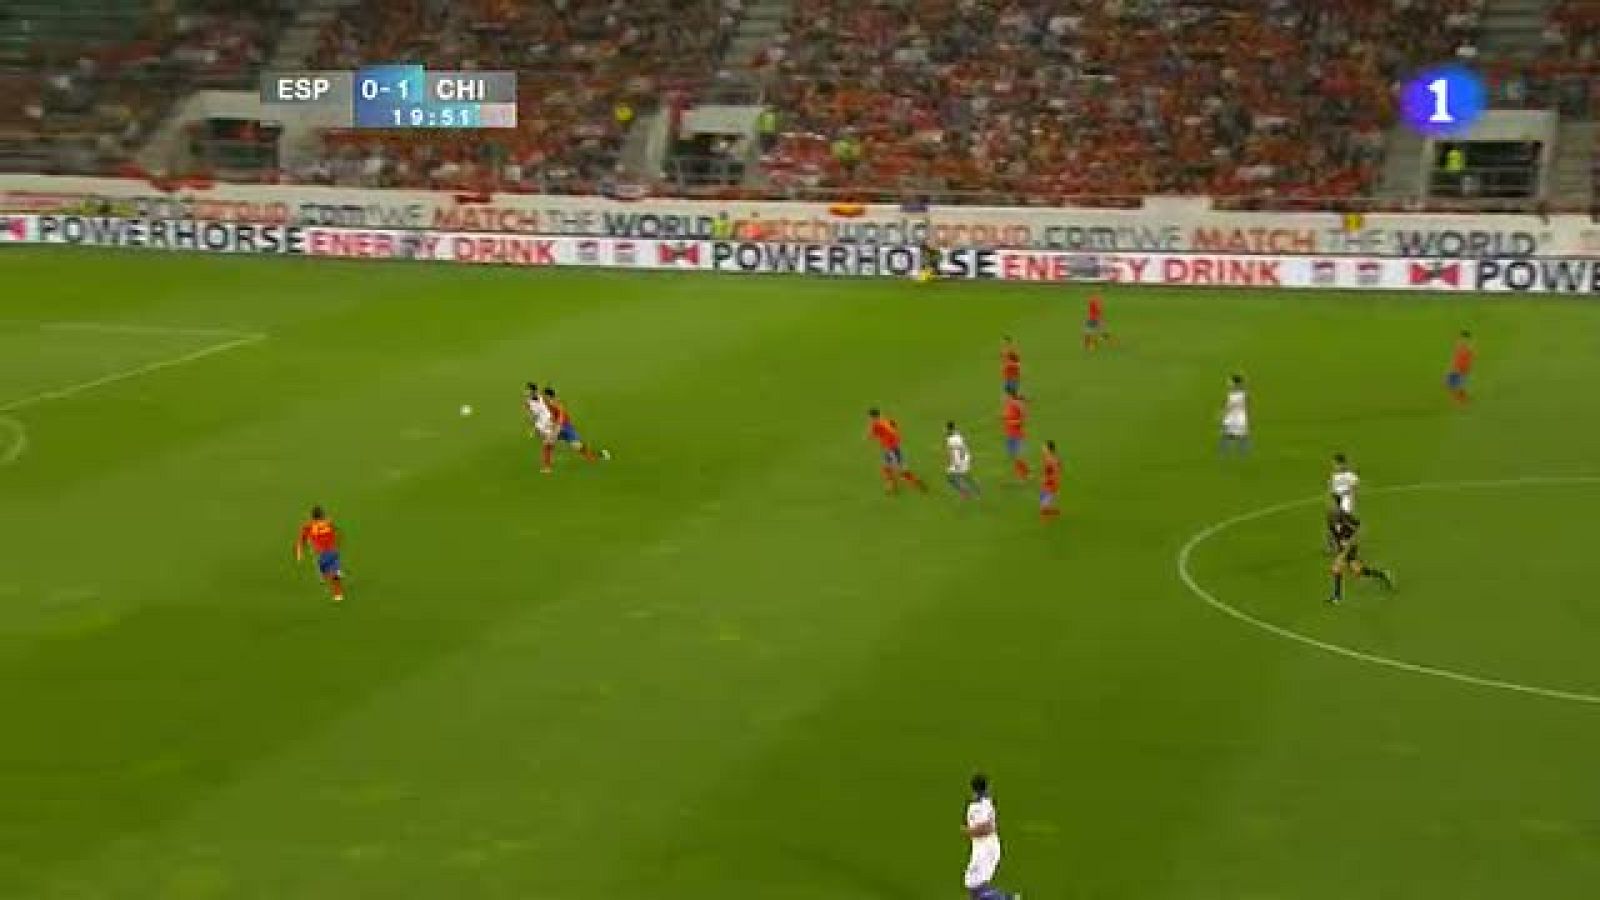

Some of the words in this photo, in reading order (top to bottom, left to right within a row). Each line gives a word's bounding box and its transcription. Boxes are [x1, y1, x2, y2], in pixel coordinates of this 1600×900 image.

[433, 207, 538, 232] MATCH
[546, 209, 598, 234] THE
[40, 217, 305, 255] POWERHORSE
[452, 237, 557, 264] DRINK
[1192, 228, 1317, 253] MATCH
[1328, 231, 1385, 254] THE
[1003, 253, 1149, 282] ENEGY
[1164, 258, 1281, 286] DRINK
